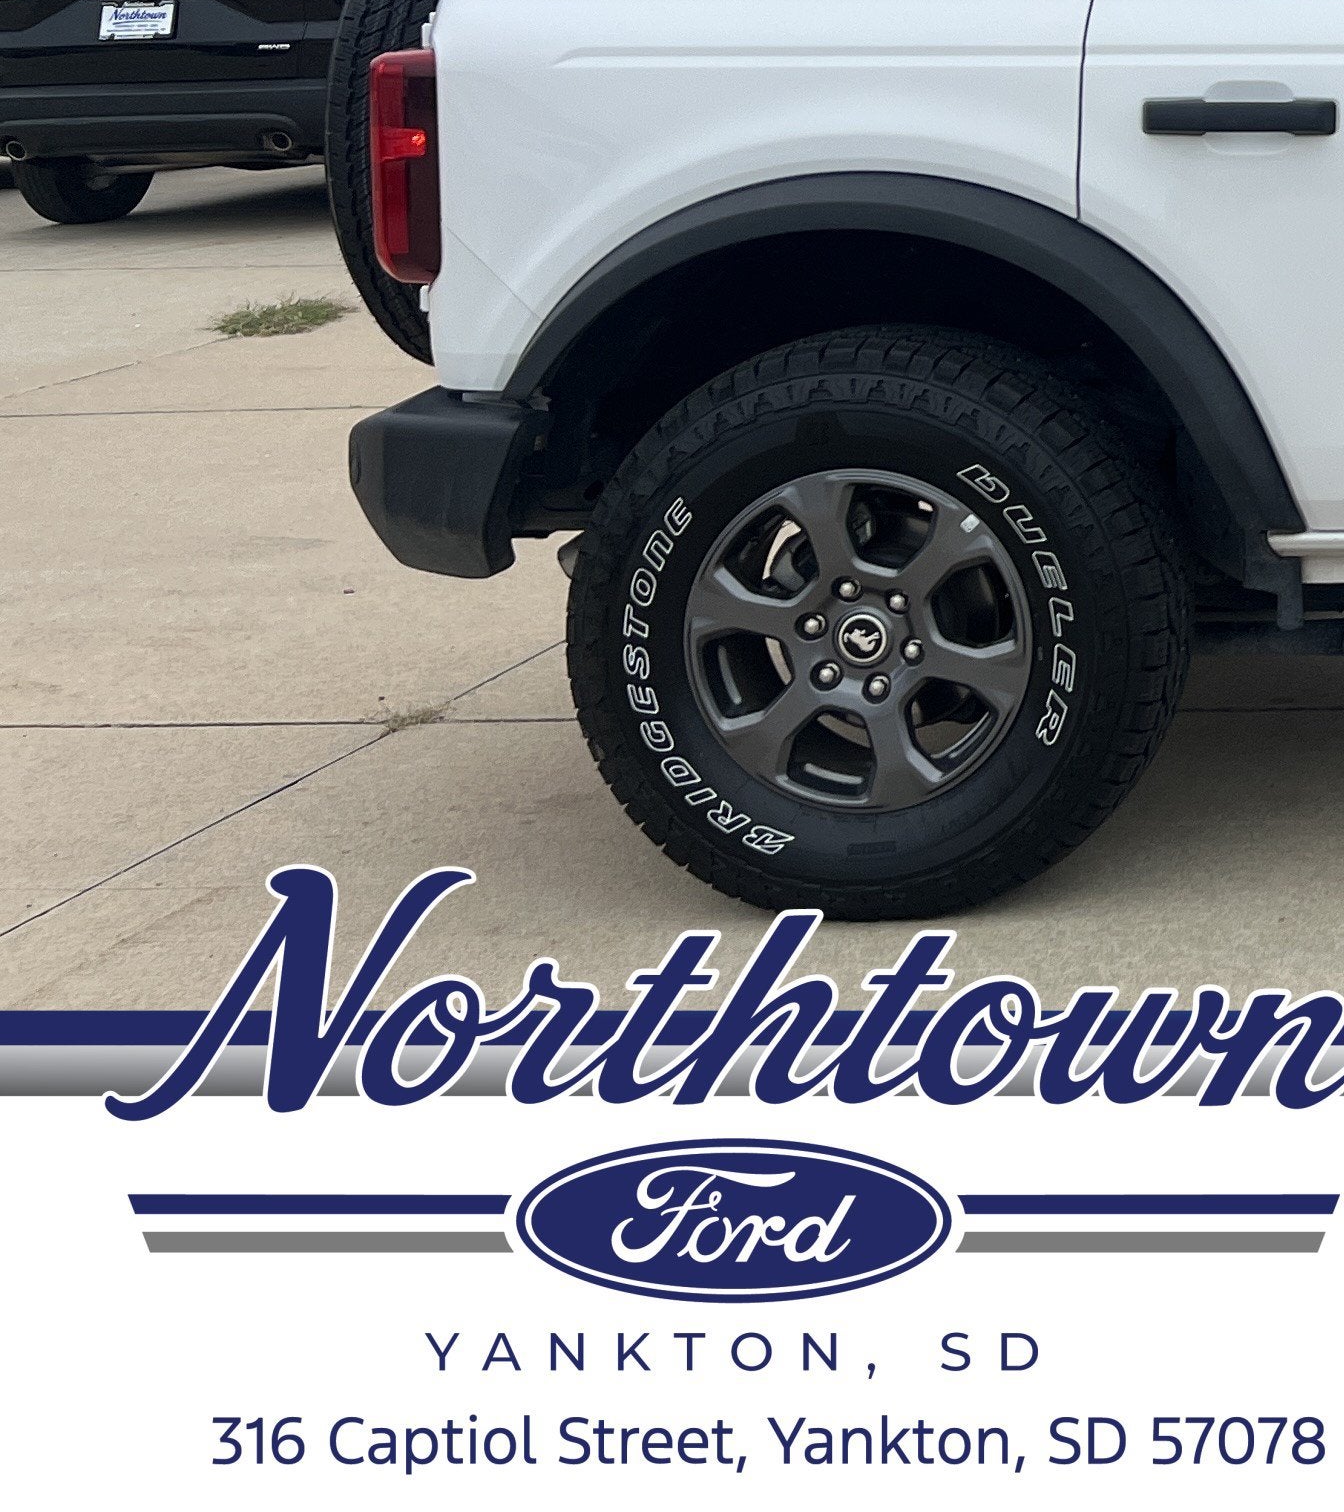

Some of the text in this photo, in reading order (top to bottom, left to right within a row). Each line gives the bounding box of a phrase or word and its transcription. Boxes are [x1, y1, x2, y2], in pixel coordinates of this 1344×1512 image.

[109, 7, 168, 21] Northtown
[623, 497, 795, 855] BRIDGESTONE
[957, 463, 1077, 746] DUELER
